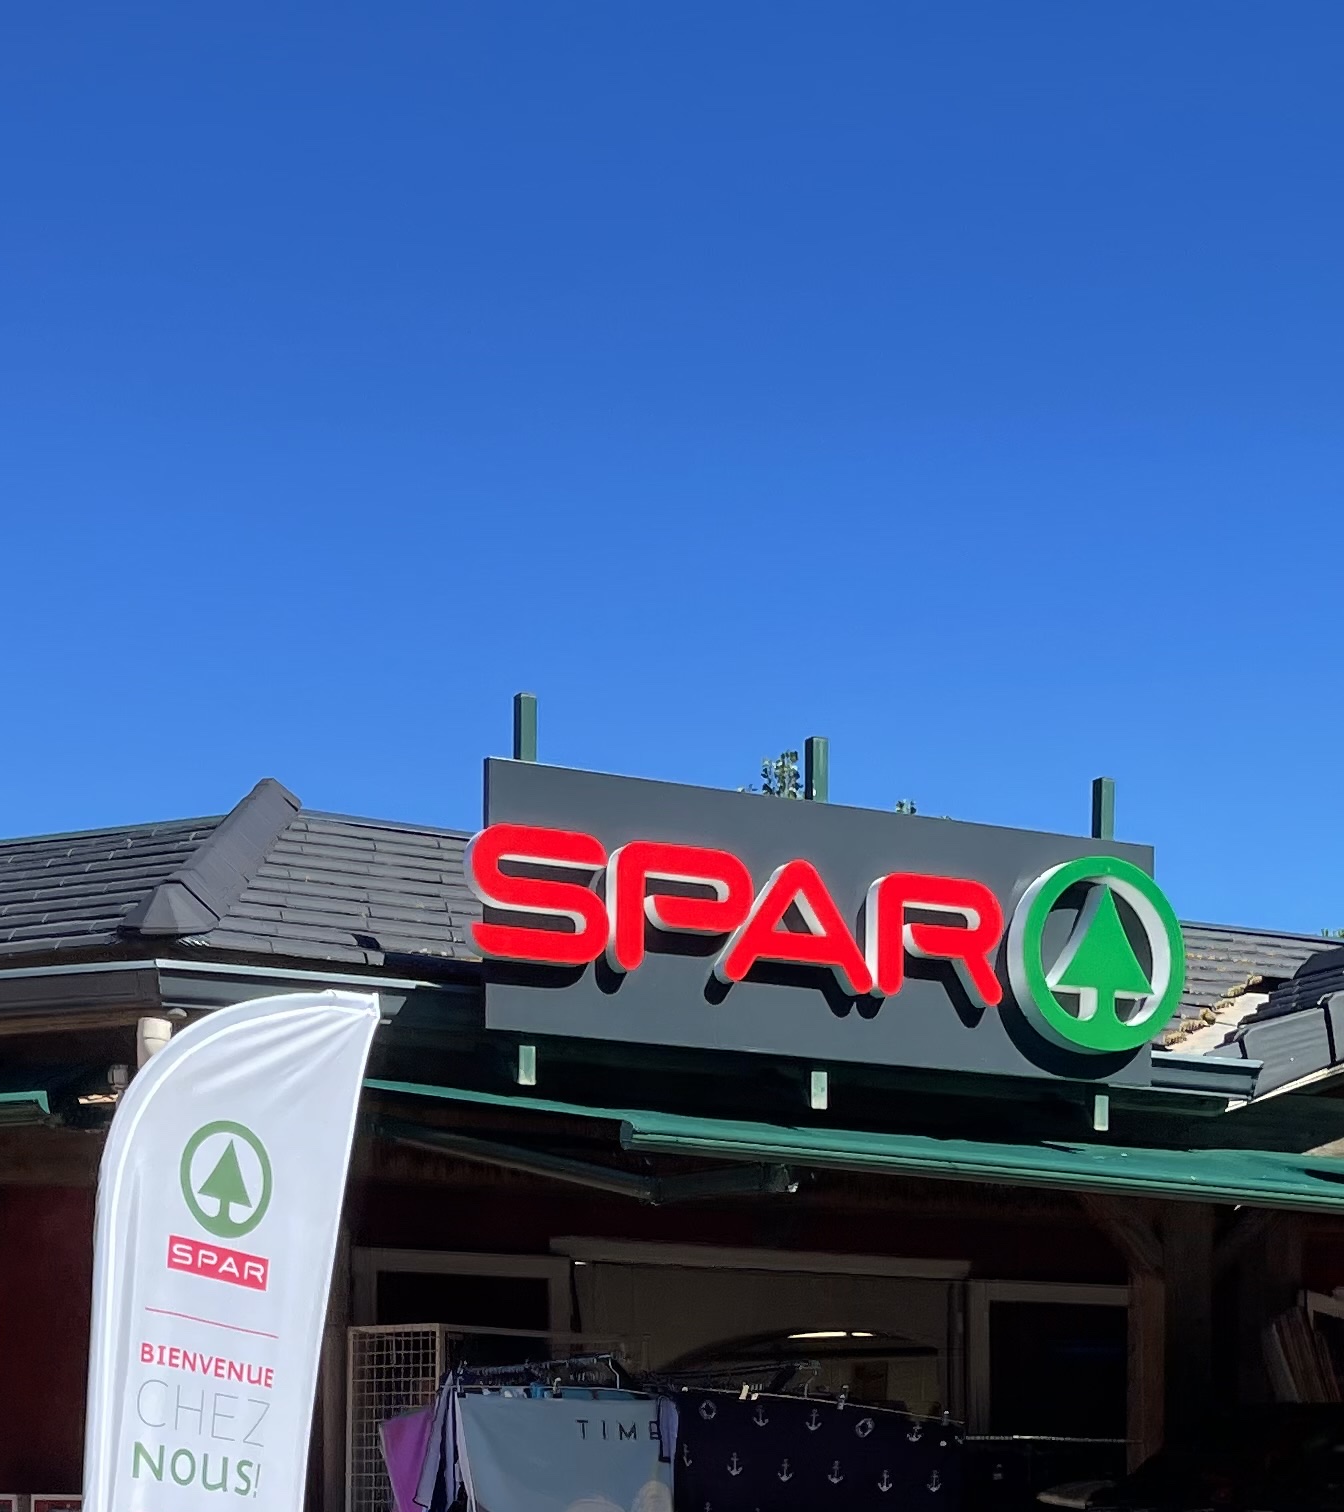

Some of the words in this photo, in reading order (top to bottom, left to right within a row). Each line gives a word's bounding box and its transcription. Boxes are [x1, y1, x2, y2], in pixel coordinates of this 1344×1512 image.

[465, 823, 1004, 1008] SPAR
[172, 1243, 265, 1284] SPAR
[140, 1342, 274, 1389] BIENVENUE
[137, 1379, 271, 1448] CHEZ
[132, 1440, 261, 1499] NOUS!
